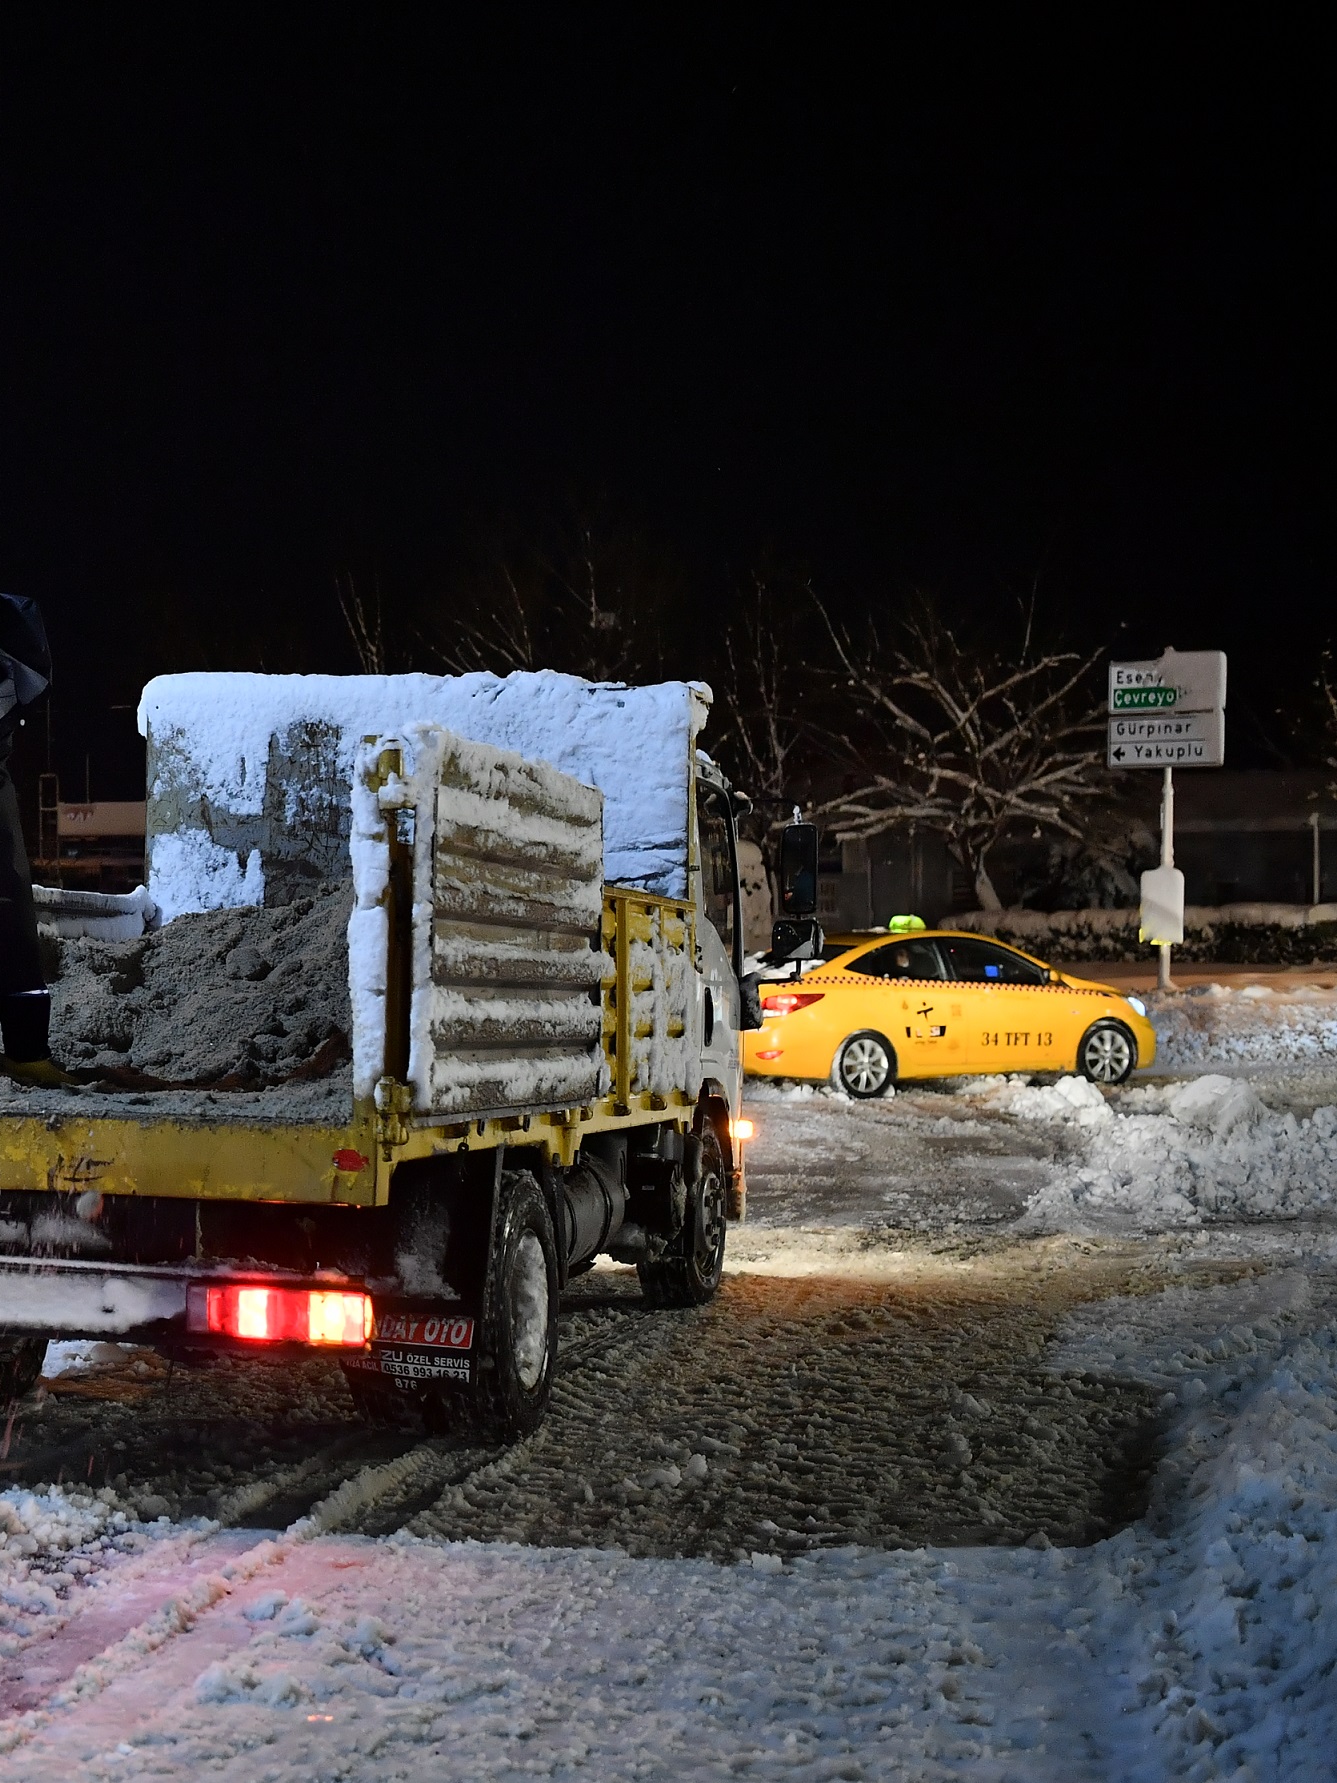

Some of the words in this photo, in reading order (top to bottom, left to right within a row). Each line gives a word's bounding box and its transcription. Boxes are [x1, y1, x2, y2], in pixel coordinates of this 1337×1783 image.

[1134, 743, 1204, 760] Yakuplu
[981, 1032, 999, 1046] 34
[1005, 1032, 1030, 1046] TFT
[1037, 1032, 1053, 1046] 13
[424, 1317, 468, 1345] OTO
[406, 1353, 432, 1366] ÖZEL
[434, 1357, 471, 1369] SERVİS
[384, 1364, 410, 1375] 0536
[412, 1366, 433, 1377] 993
[435, 1369, 450, 1378] 16
[395, 1378, 418, 1390] 876
